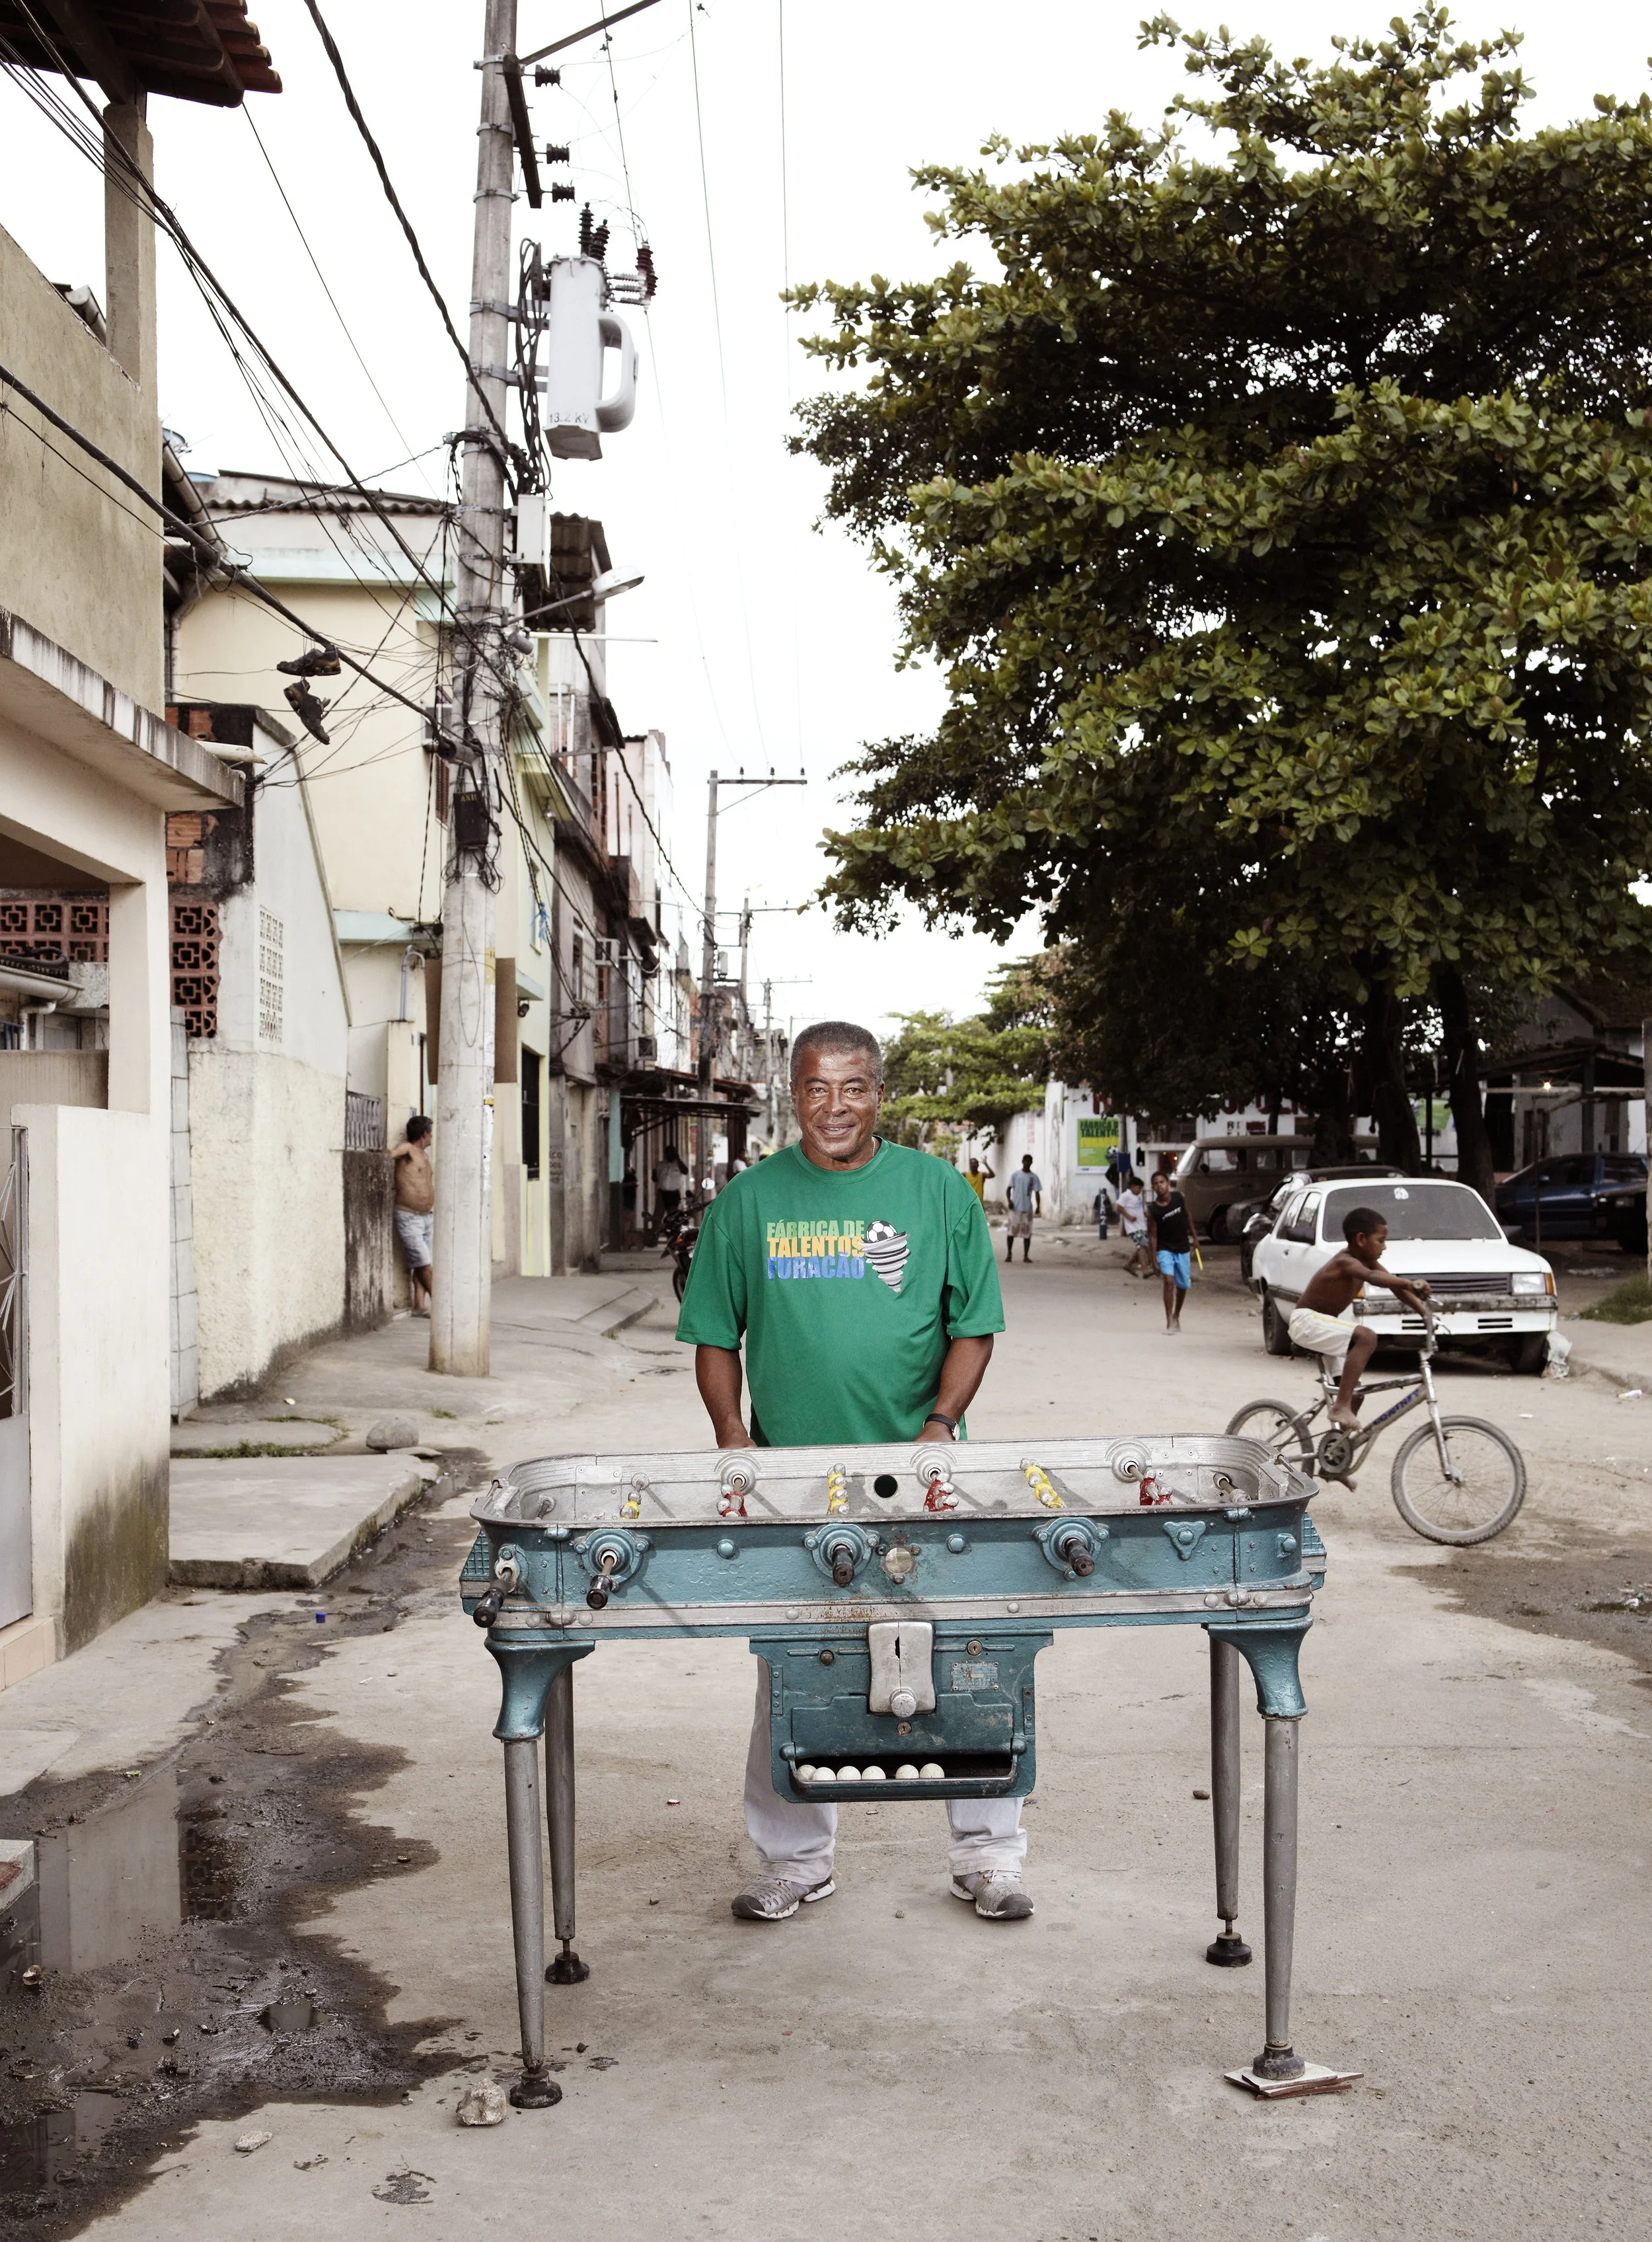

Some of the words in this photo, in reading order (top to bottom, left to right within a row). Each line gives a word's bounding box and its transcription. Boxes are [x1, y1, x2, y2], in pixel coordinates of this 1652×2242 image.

[767, 1219, 838, 1240] FÁBRICA
[843, 1220, 865, 1238] DE
[767, 1236, 866, 1257] TALENTOS
[767, 1252, 866, 1280] FURACÃO
